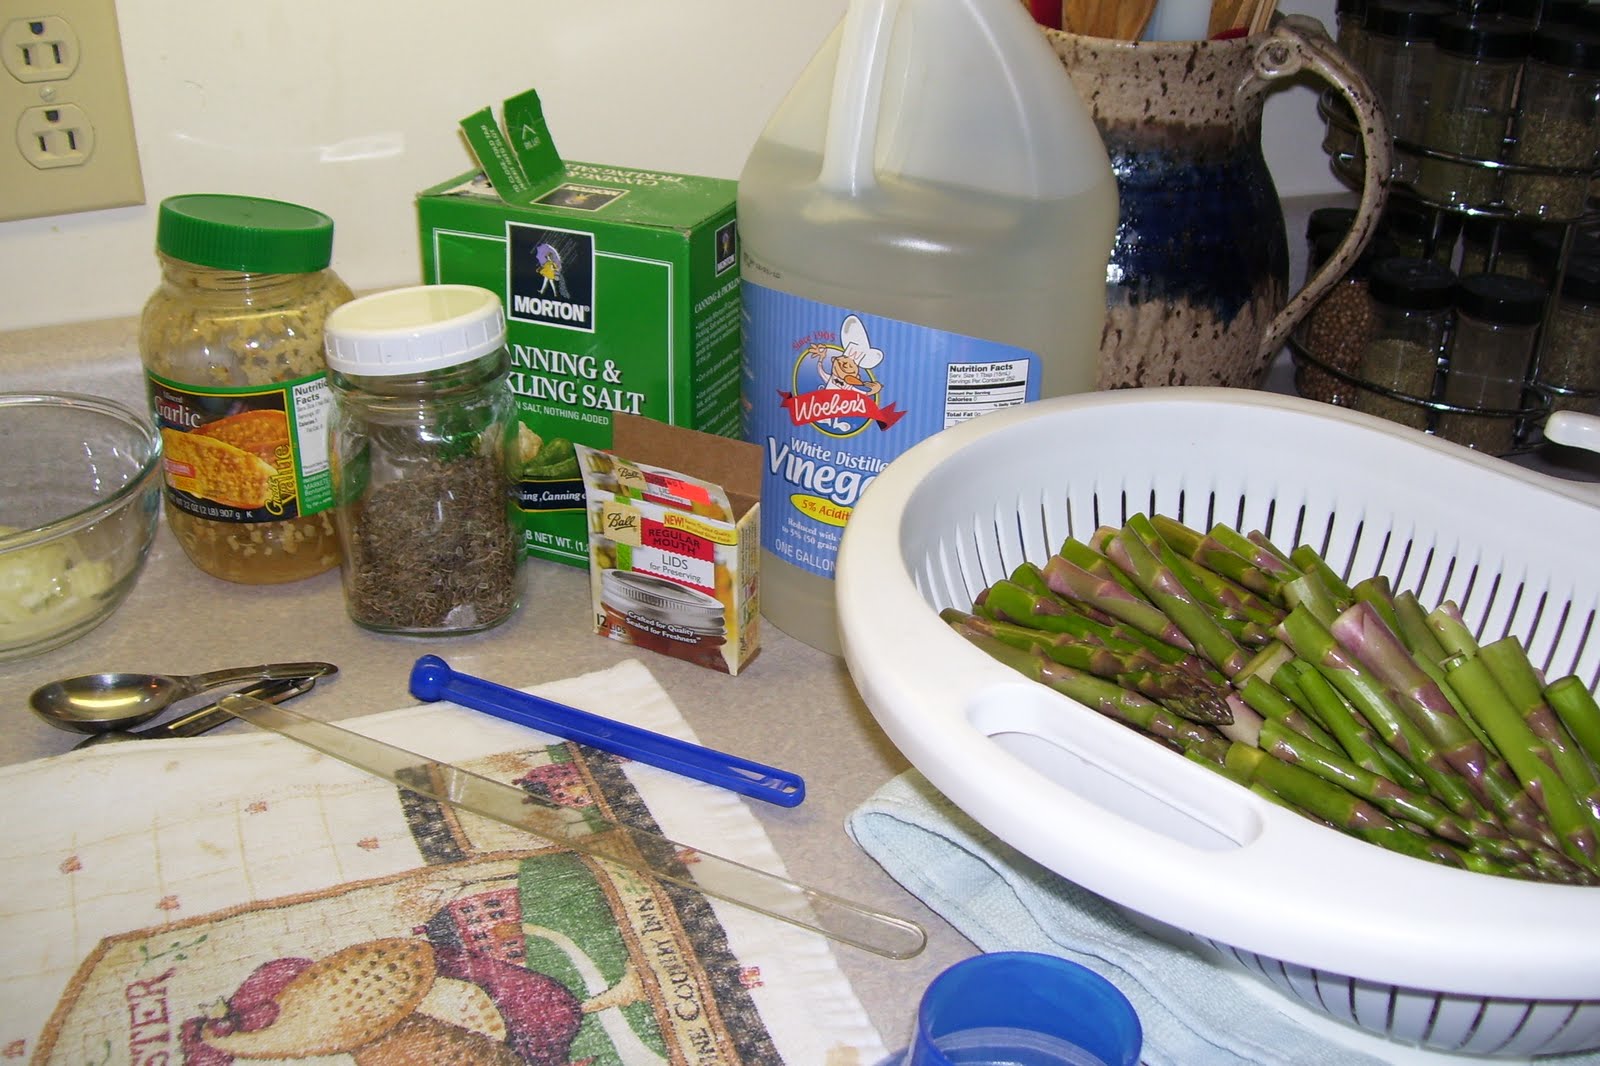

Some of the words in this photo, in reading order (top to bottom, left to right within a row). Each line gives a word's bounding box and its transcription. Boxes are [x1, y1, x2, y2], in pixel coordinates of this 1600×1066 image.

[514, 294, 586, 322] MORTON
[813, 331, 837, 342] 1905
[504, 343, 598, 380] ANNING
[602, 359, 623, 385] &
[949, 365, 988, 373] Nutrition
[990, 363, 1013, 372] Facts
[294, 379, 329, 396] Nutritio
[504, 371, 578, 405] KLING
[582, 384, 646, 416] SALT
[295, 393, 320, 406] Facts
[794, 393, 867, 422] Woeber's
[155, 395, 201, 429] Garlic
[522, 402, 543, 416] SALT,
[543, 406, 580, 421] NOTHING
[581, 413, 609, 426] ADDED
[791, 436, 832, 462] White
[835, 451, 890, 473] Distille
[264, 477, 285, 516] Great
[275, 443, 298, 504] Value
[617, 466, 642, 480] Ball
[767, 436, 878, 506] Vineg
[219, 508, 234, 518] 907
[801, 499, 817, 511] 5%
[818, 505, 853, 520] Acidit
[607, 512, 637, 531] Ball
[664, 514, 685, 527] NEW!
[787, 517, 817, 536] Reduced
[818, 531, 837, 541] with
[534, 531, 553, 545] NET
[554, 536, 573, 550] WT.
[648, 528, 701, 549] REGULAR
[789, 528, 802, 540] 5%
[653, 537, 696, 556] MOUTH
[775, 538, 794, 558] ONE
[661, 553, 688, 570] LIDS
[649, 562, 661, 572] for
[662, 565, 702, 583] Preserving
[596, 612, 608, 628] 12
[625, 617, 649, 632] Sealed
[650, 626, 661, 636] for
[627, 610, 655, 626] Crafted
[655, 620, 666, 630] for
[667, 624, 694, 638] Quality
